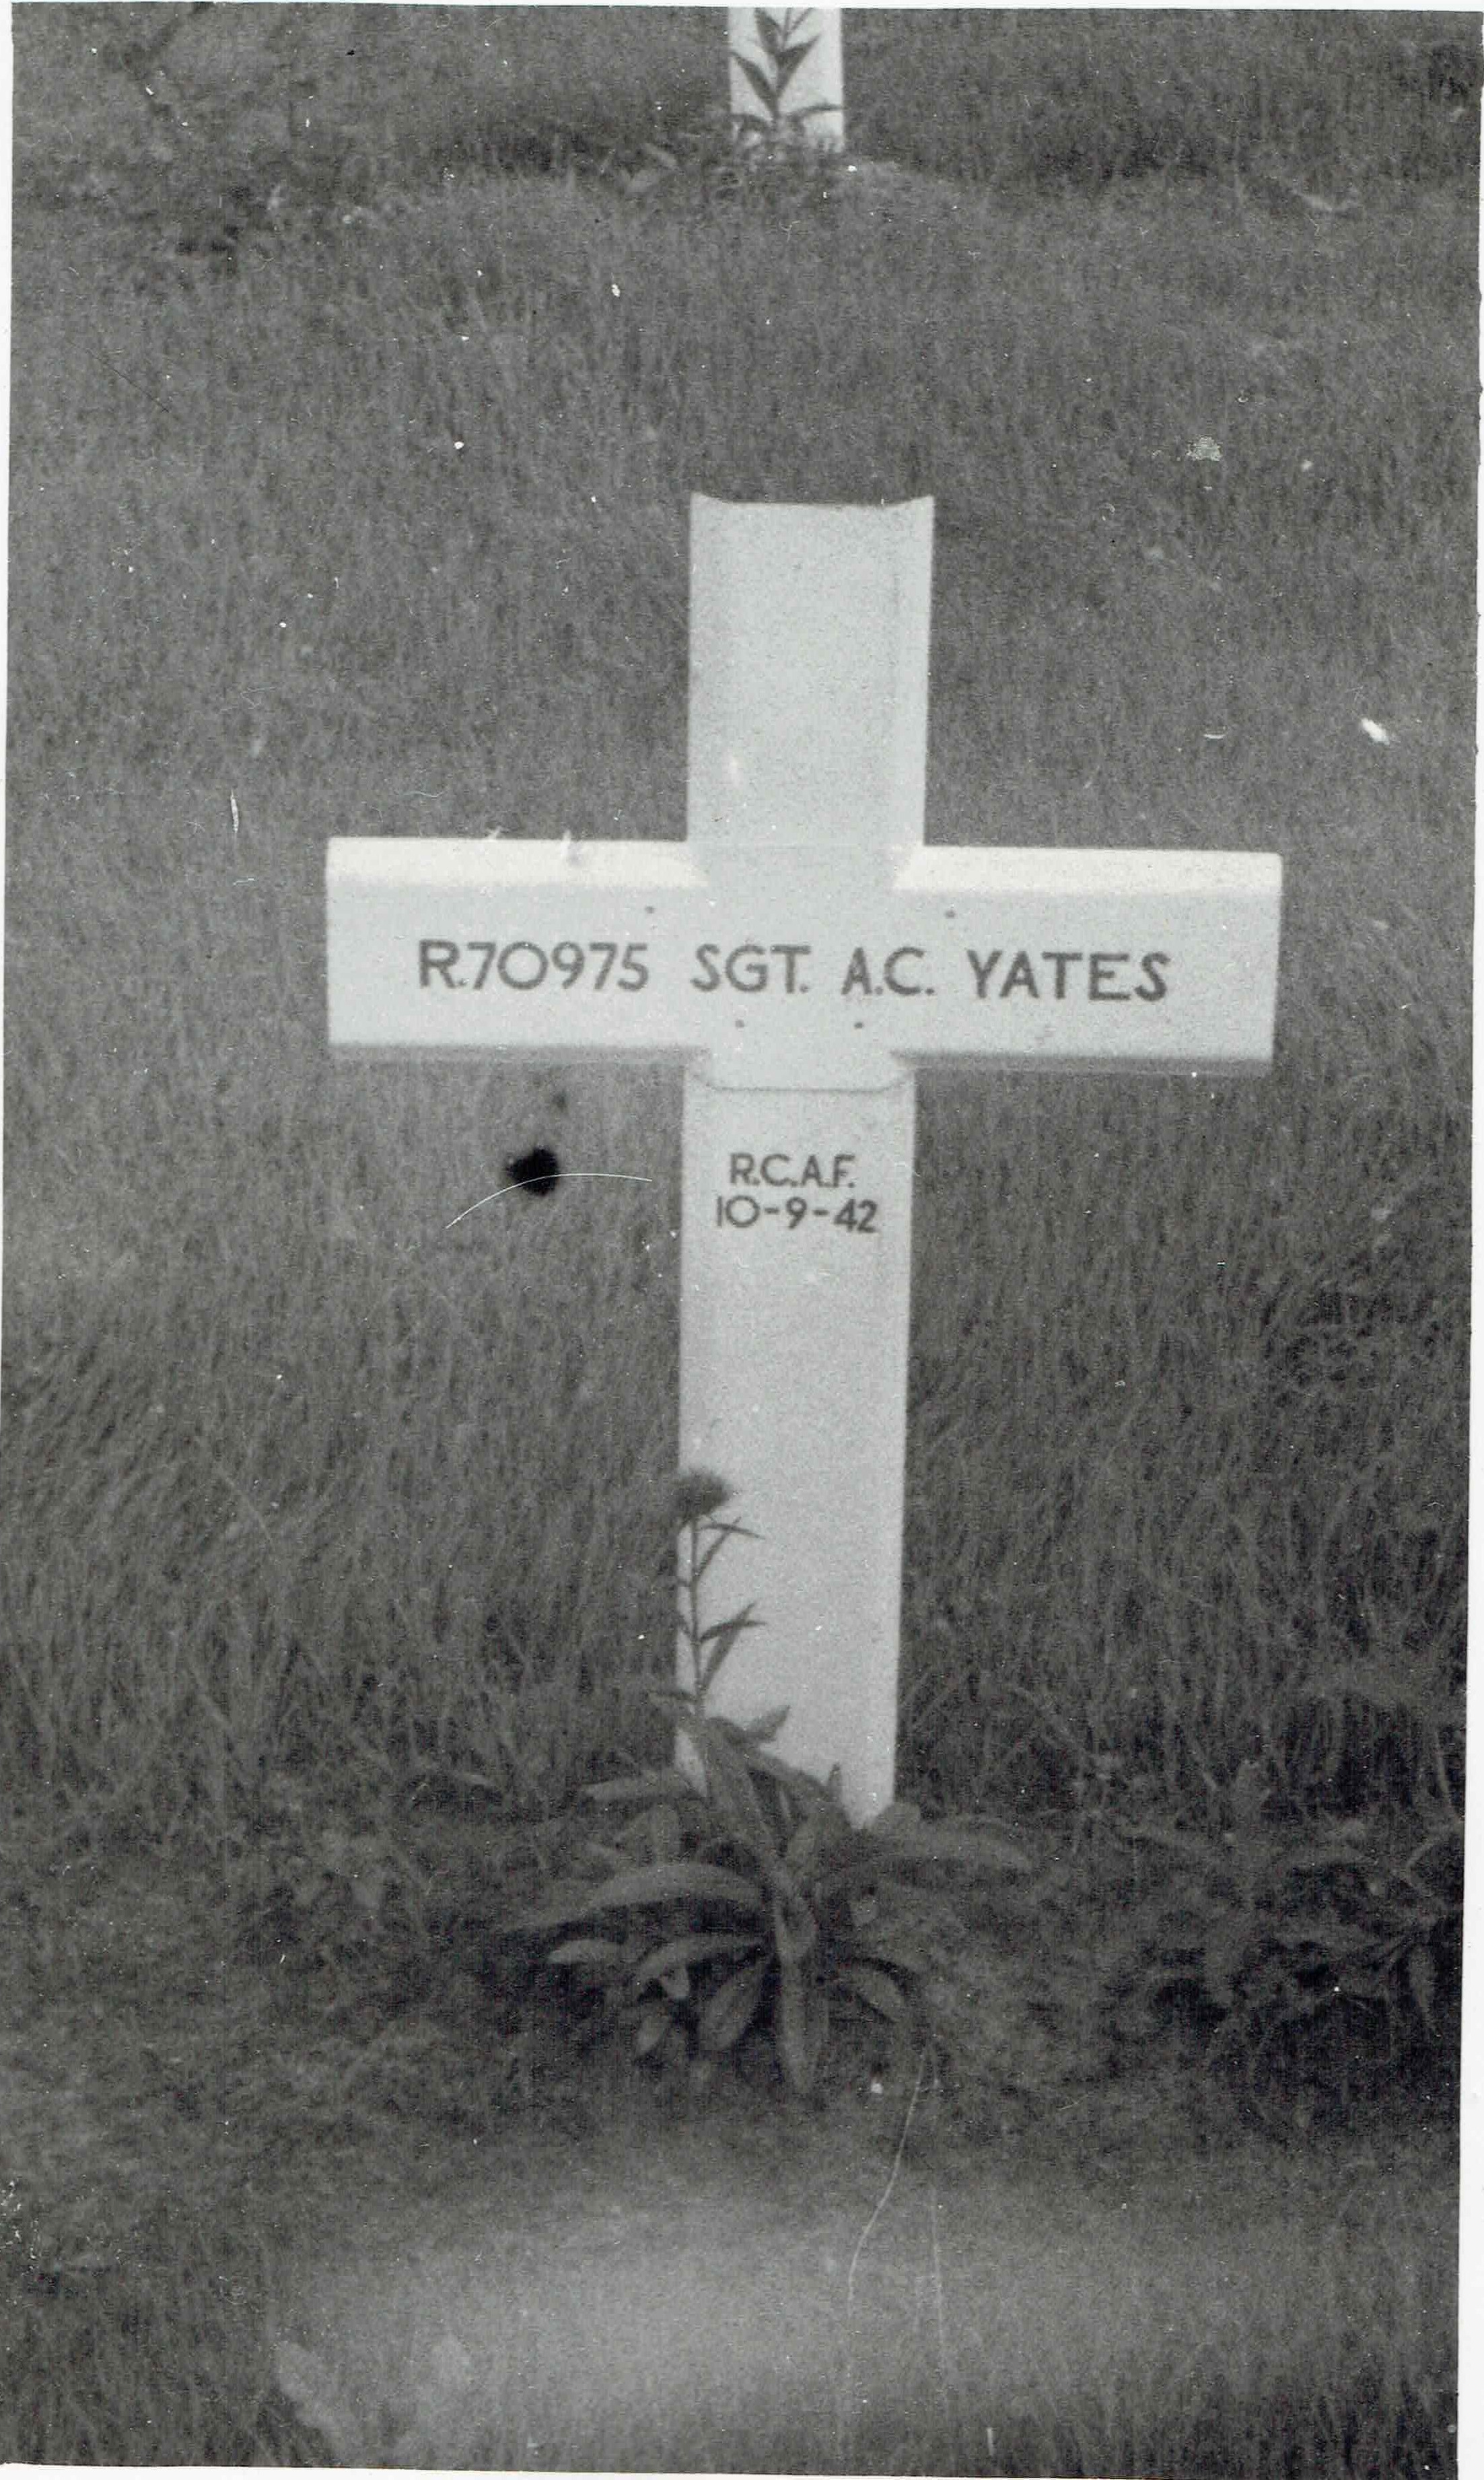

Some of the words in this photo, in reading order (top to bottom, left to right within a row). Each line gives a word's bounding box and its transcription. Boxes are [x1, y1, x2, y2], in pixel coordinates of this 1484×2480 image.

[419, 940, 649, 992] R.70975
[692, 944, 812, 994] SGT.
[841, 946, 935, 997] A.C.
[966, 949, 1172, 1002] YATES
[729, 1152, 856, 1190] R.C.A.F.
[716, 1194, 880, 1235] 10-9-42
